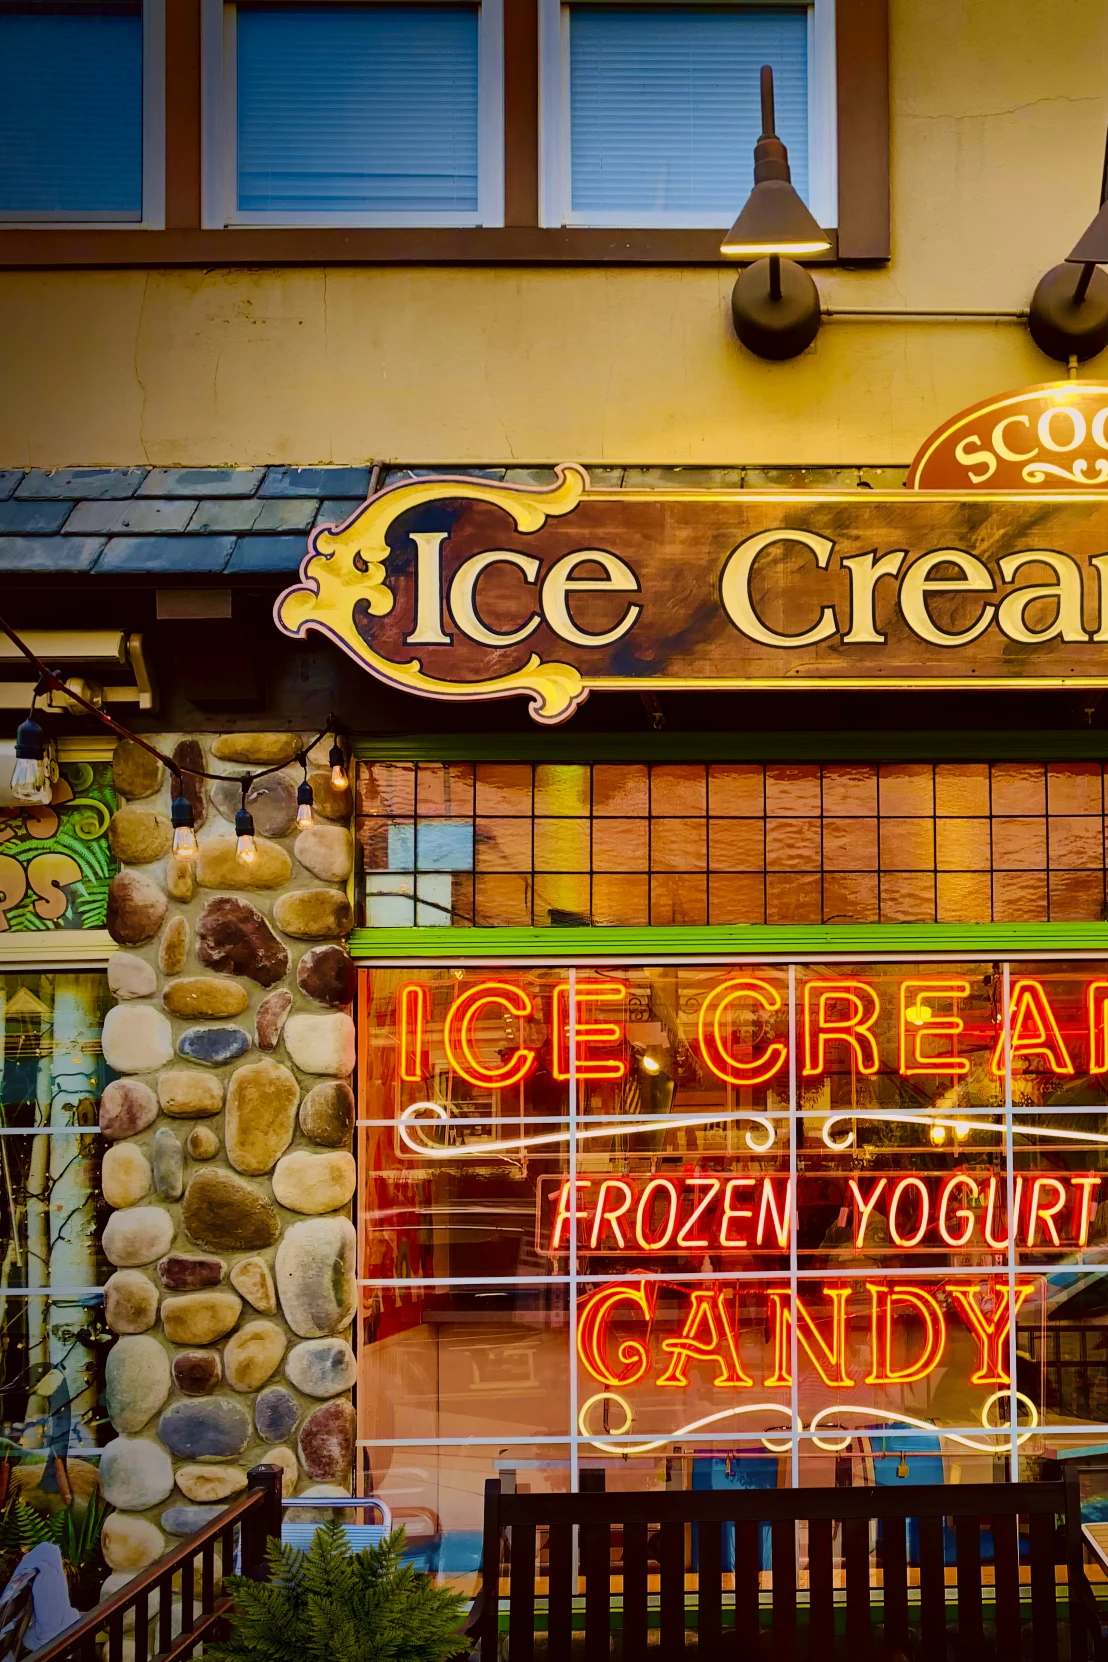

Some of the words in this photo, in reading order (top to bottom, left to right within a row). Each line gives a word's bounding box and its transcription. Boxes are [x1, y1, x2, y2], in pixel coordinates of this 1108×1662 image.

[403, 531, 643, 647] Ice
[399, 979, 628, 1089] ICE
[551, 1176, 793, 1251] FROZEN
[848, 1175, 1101, 1250] YOGURT
[577, 1278, 1036, 1387] CANDY
